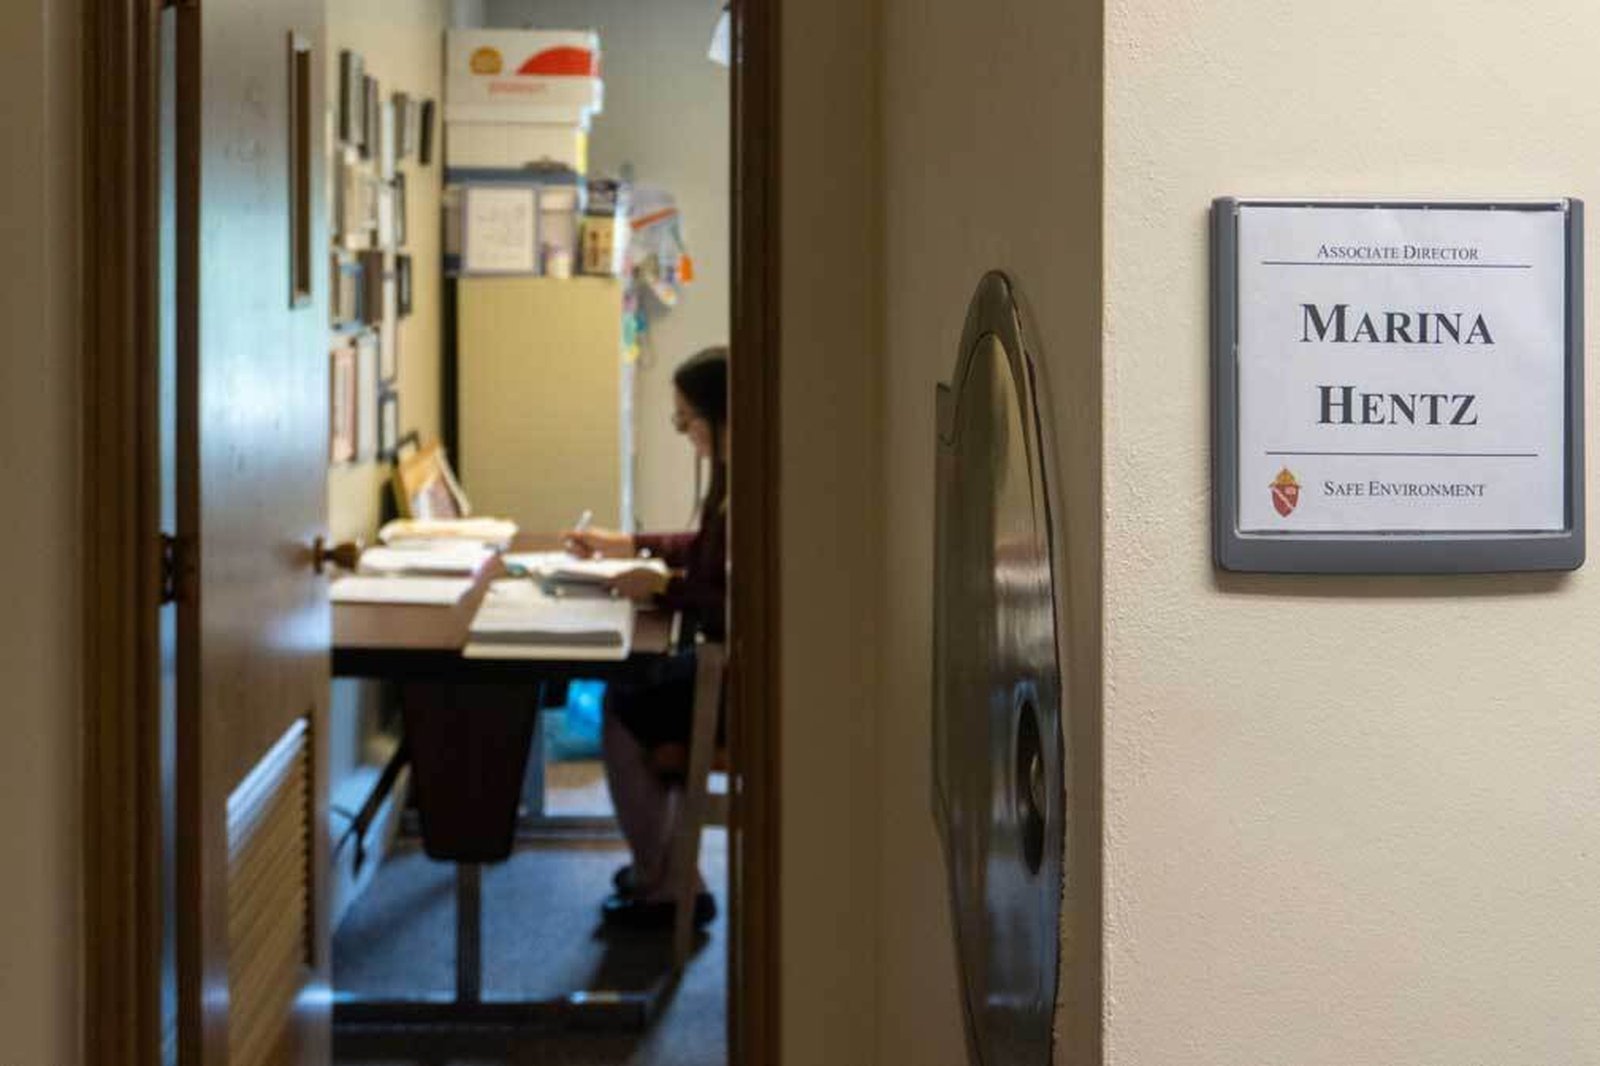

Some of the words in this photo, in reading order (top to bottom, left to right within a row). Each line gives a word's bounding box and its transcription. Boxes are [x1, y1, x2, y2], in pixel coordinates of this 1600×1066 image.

[1317, 243, 1400, 260] ASSOCIATE
[1402, 244, 1479, 262] DIRECTOR
[1299, 303, 1496, 345] MARINA
[1316, 385, 1479, 427] HENTZ
[1323, 480, 1365, 498] SAFE
[1367, 480, 1487, 499] ENVIRONMENT
